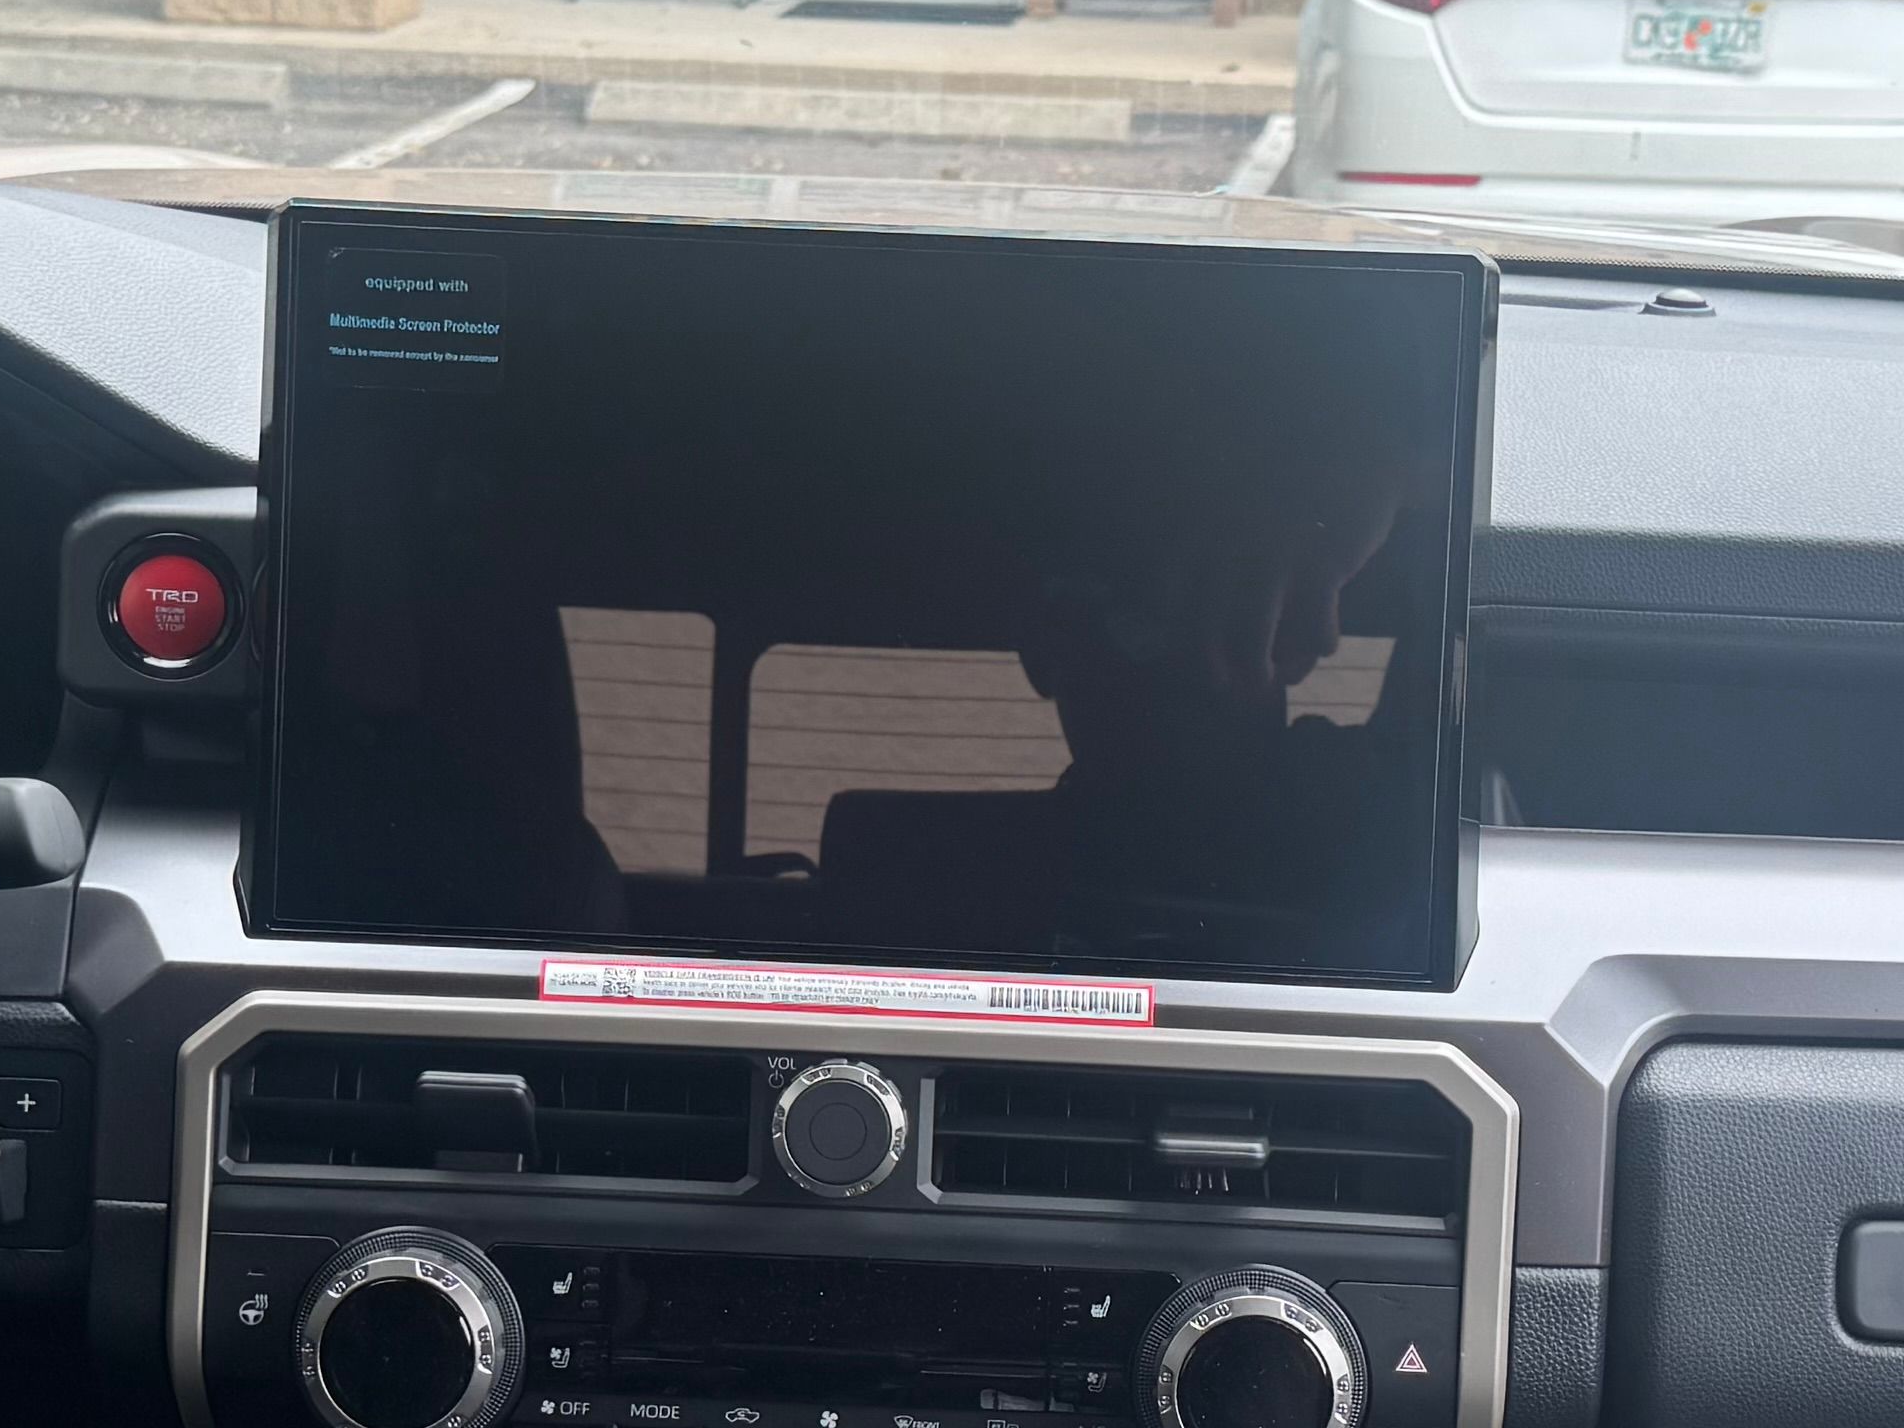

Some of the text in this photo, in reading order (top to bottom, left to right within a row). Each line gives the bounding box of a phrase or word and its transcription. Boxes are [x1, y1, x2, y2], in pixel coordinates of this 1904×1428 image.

[365, 276, 469, 293] equipped with
[329, 313, 500, 335] Multimedia Screen Protector
[146, 588, 199, 603] TRD
[155, 614, 186, 623] START
[158, 623, 185, 632] STOP
[768, 1056, 796, 1069] VOL
[560, 1401, 591, 1416] OFF
[630, 1404, 680, 1420] MODE
